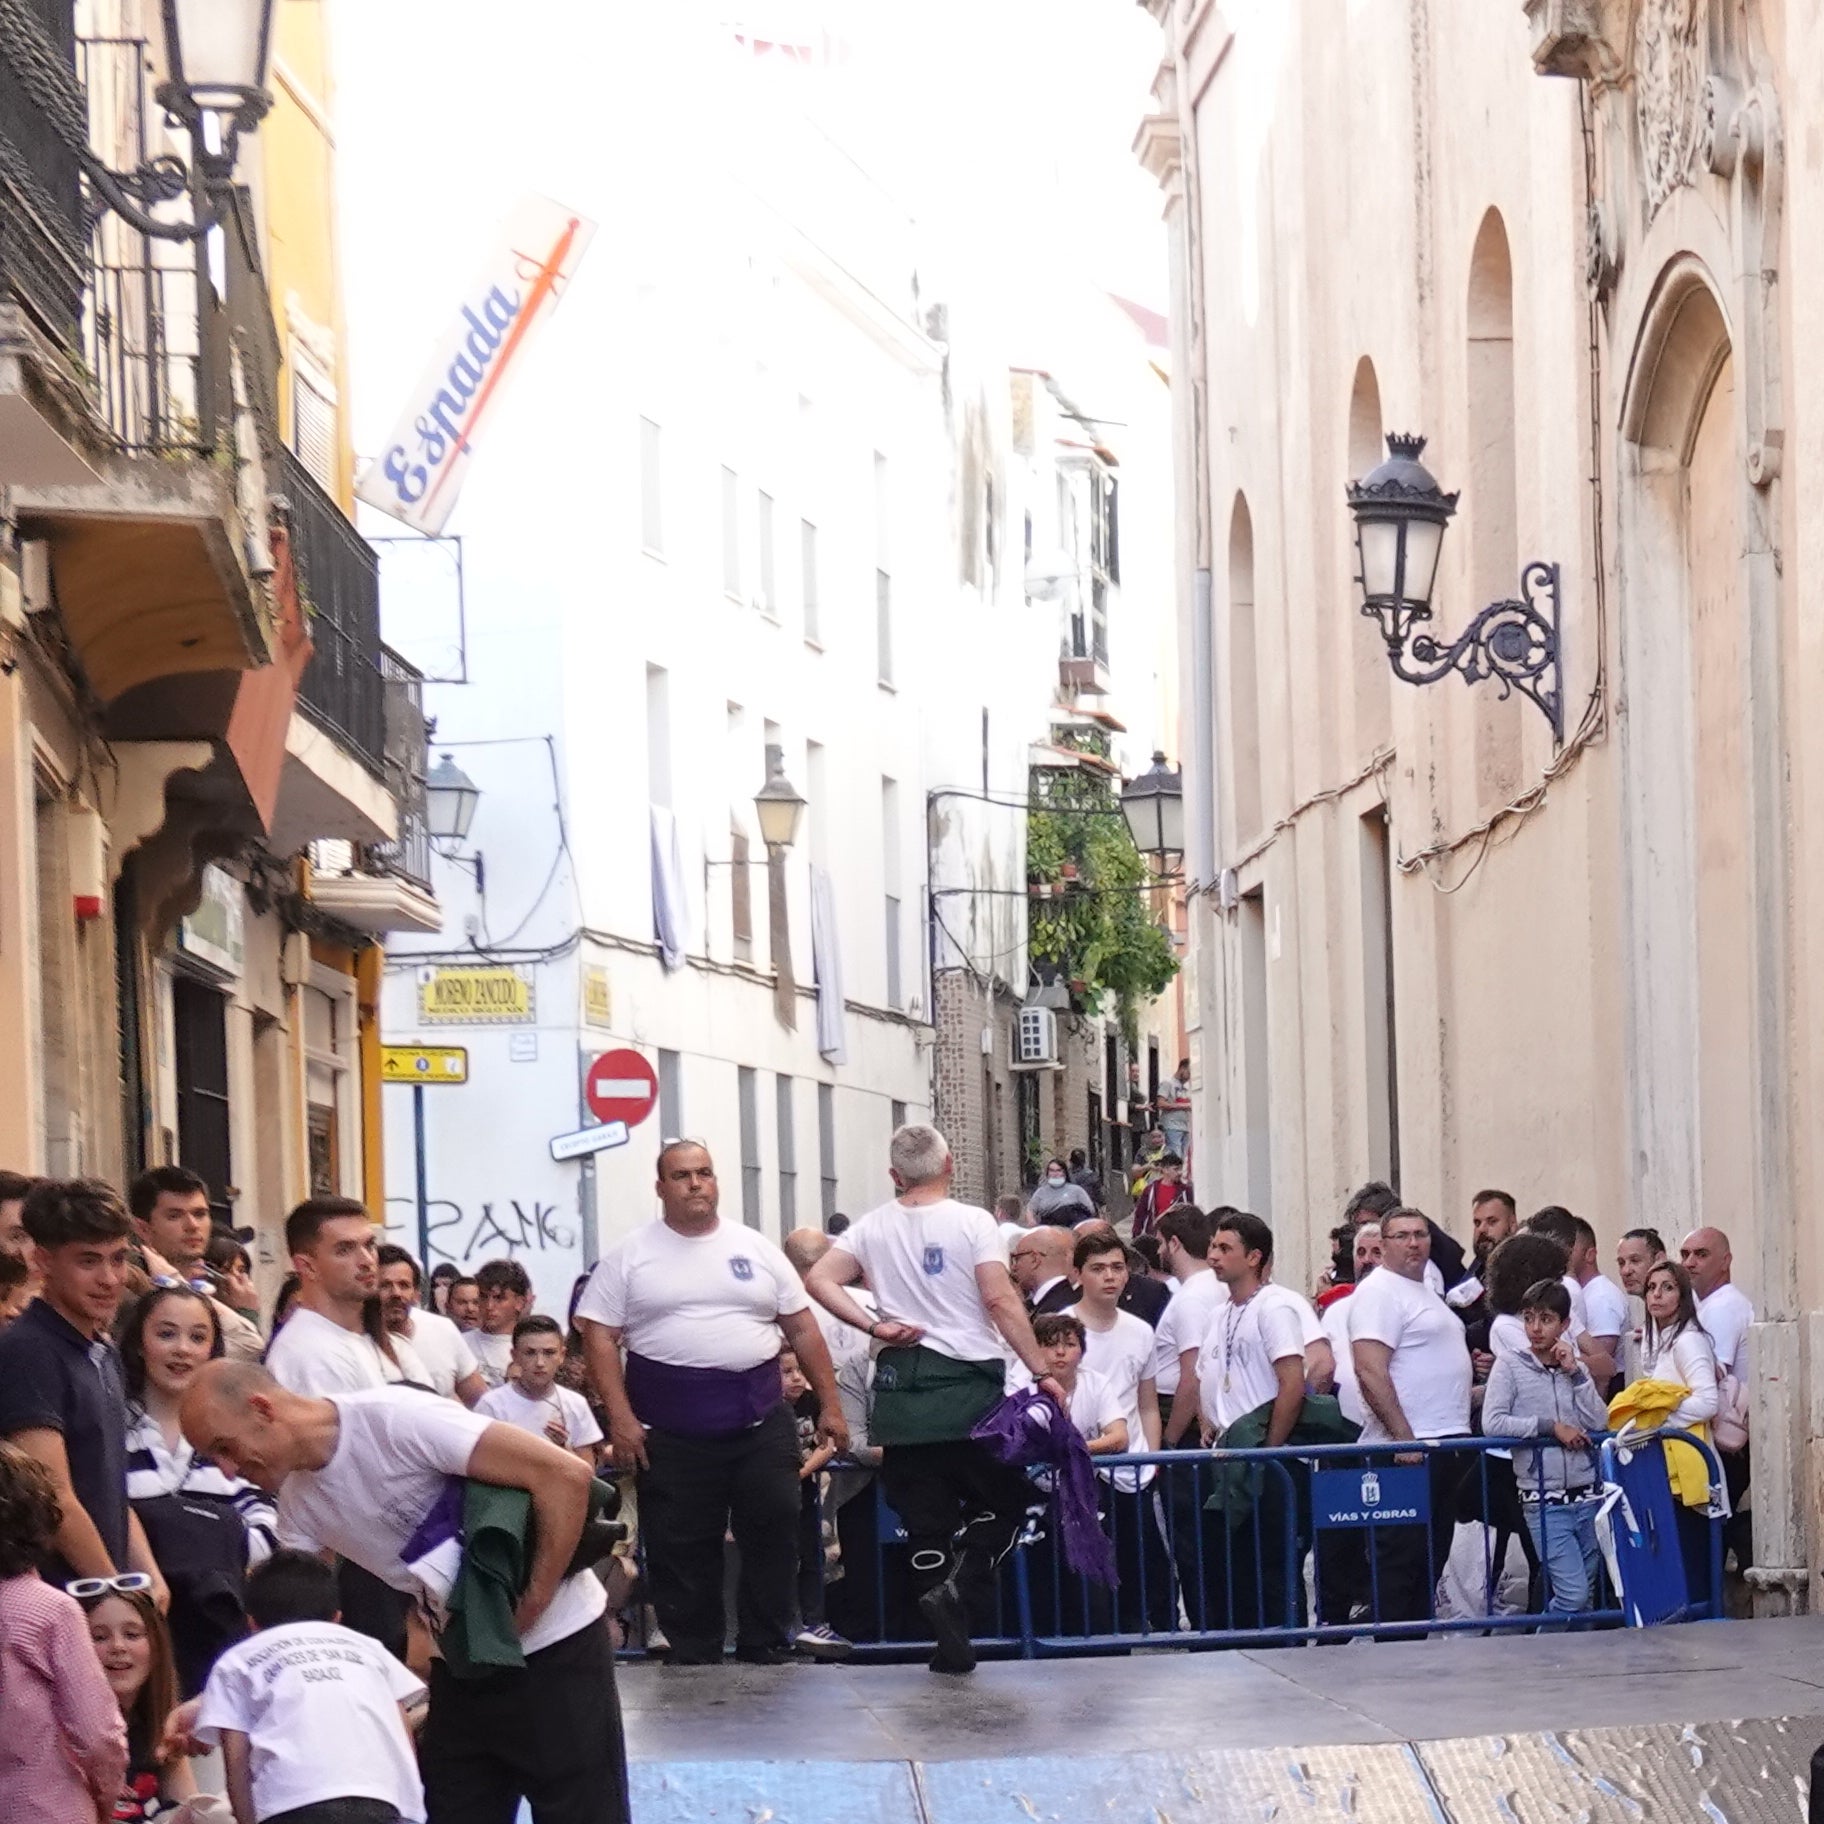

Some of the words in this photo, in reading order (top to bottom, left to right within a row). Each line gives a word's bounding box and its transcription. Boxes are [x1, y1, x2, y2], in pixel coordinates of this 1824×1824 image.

[384, 284, 521, 504] Espada
[1361, 1511, 1370, 1521] Y
[1372, 1508, 1417, 1520] OBRAS
